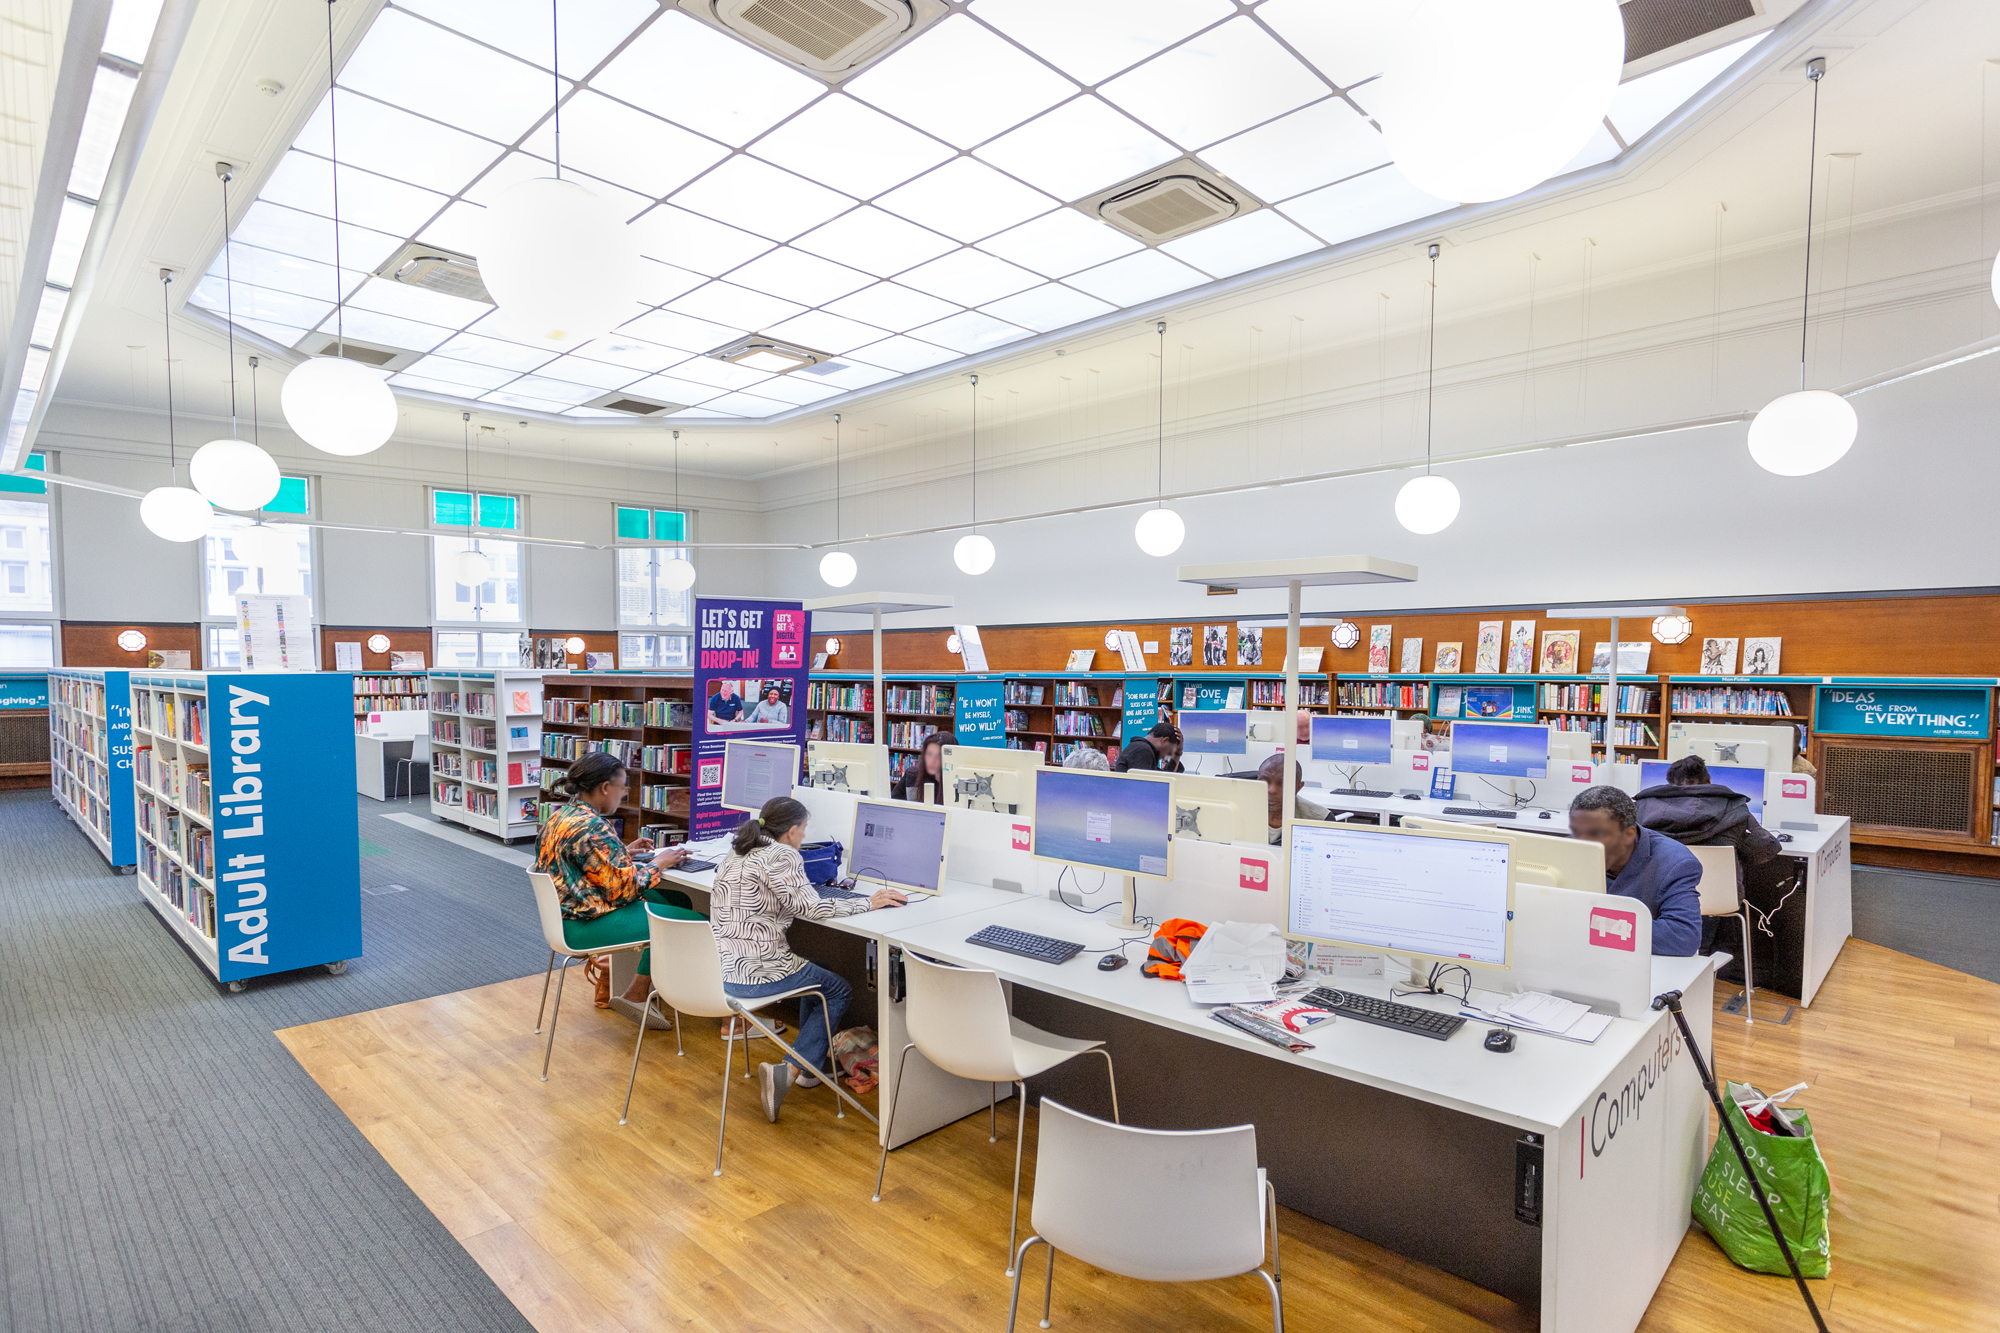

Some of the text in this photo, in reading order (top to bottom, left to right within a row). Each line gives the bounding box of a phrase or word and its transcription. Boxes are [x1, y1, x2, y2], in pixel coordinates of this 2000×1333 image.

[702, 608, 763, 629] LET'S GET
[776, 614, 792, 623] LET'S
[776, 623, 787, 631] GET
[701, 630, 750, 649] DIGITAL
[776, 632, 796, 640] DIGITAL
[700, 648, 759, 669] DROP-IN!
[1197, 689, 1221, 699] OVE
[975, 698, 997, 708] WON'T
[959, 723, 976, 732] WHO
[219, 684, 270, 965] Adult Library
[1591, 1025, 1681, 1158] Computers
[1706, 1168, 1735, 1212] USE.
